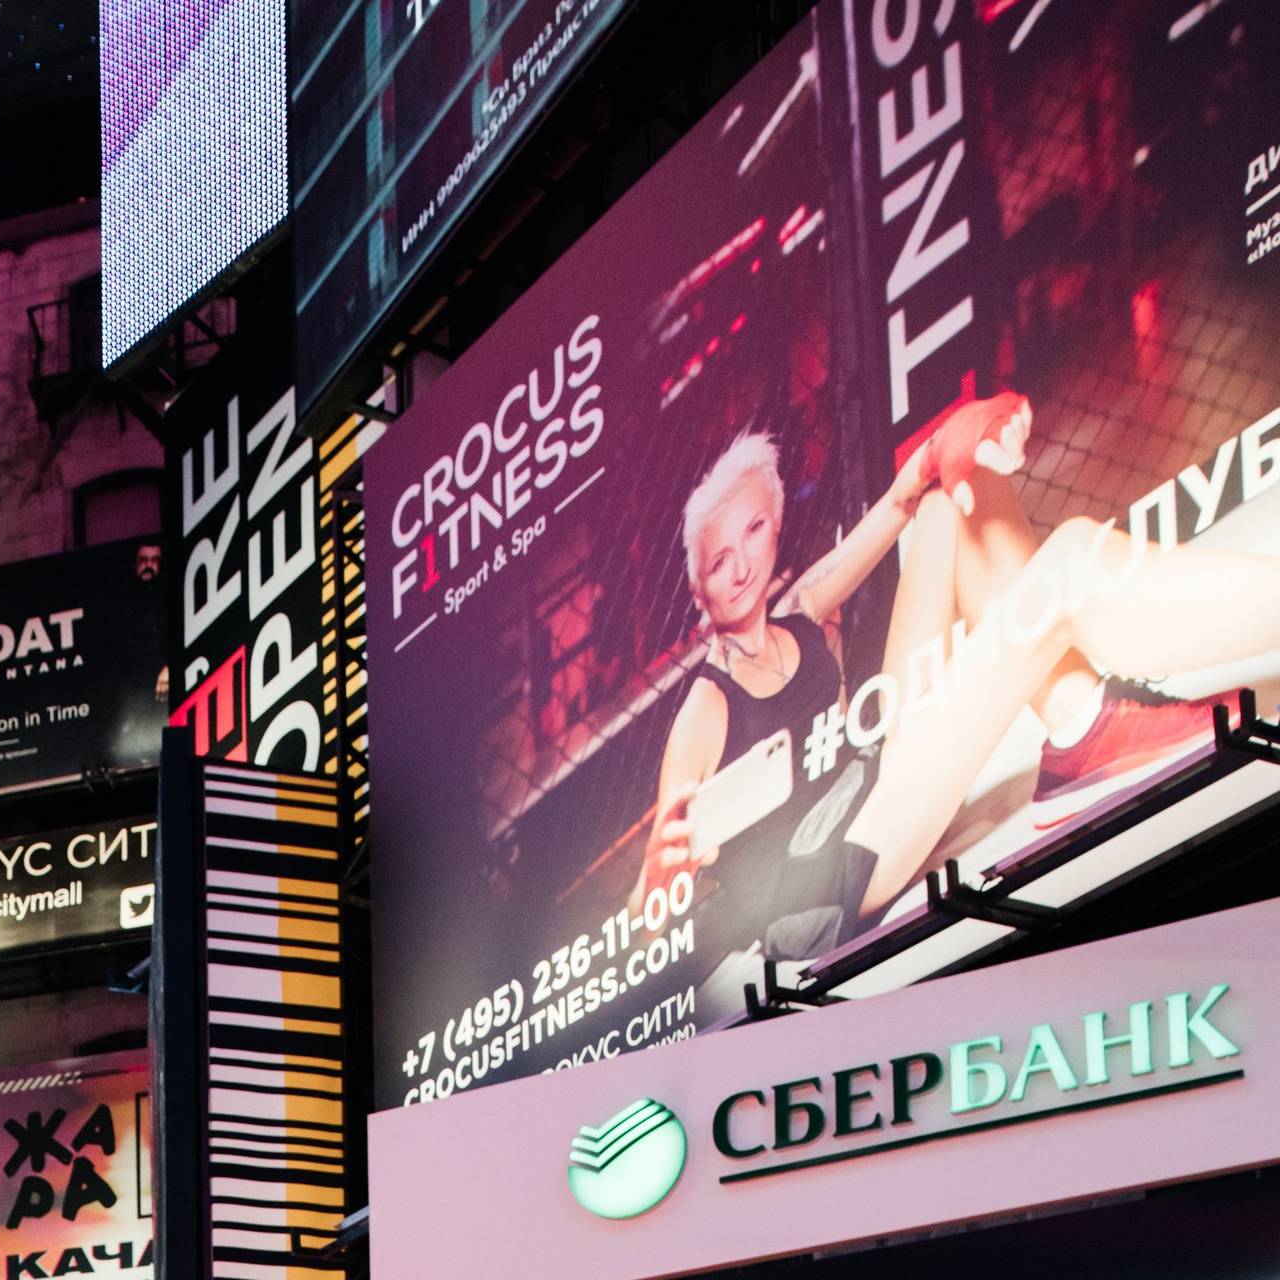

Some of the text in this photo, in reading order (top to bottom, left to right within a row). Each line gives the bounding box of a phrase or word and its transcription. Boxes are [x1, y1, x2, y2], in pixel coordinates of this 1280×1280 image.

[391, 314, 603, 548] CROCUS
[444, 515, 547, 614] Sport & Spa
[24, 711, 41, 727] in
[47, 703, 90, 723] Time
[402, 870, 694, 1077] +7 (495) 236-11-00
[625, 985, 696, 1047] СИТИ
[712, 983, 1240, 1160] СБЕРБАНК
